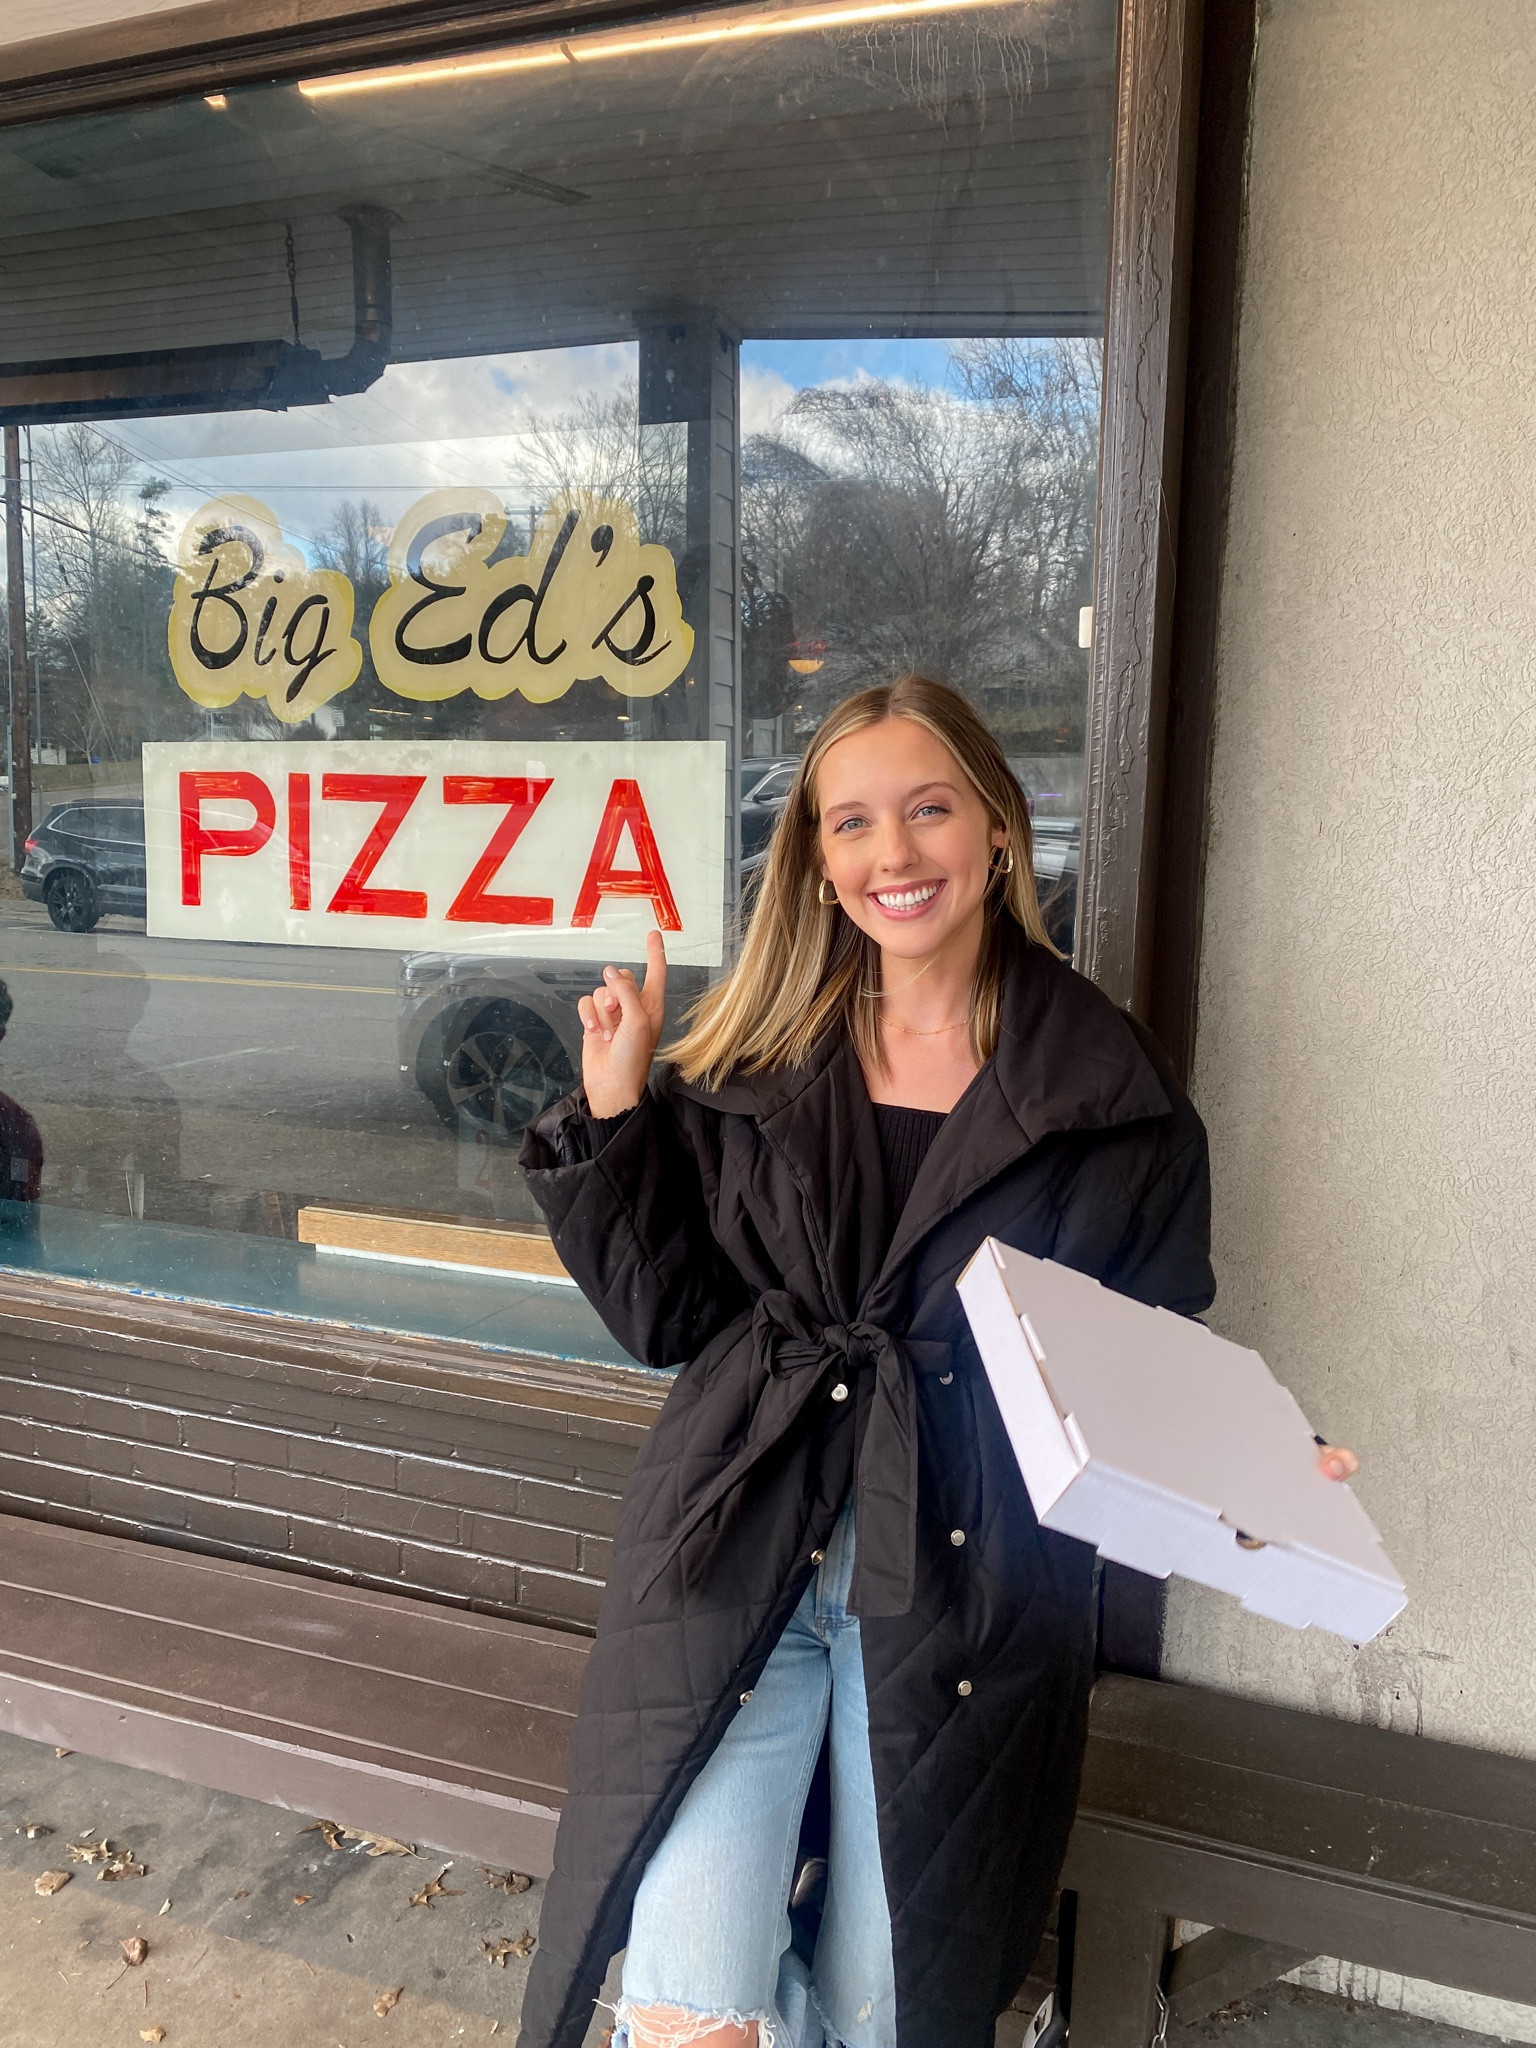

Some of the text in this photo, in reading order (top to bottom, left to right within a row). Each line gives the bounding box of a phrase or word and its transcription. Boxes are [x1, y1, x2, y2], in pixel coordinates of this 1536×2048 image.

[190, 509, 672, 704] Big Ed's
[179, 771, 684, 932] PIZZA
